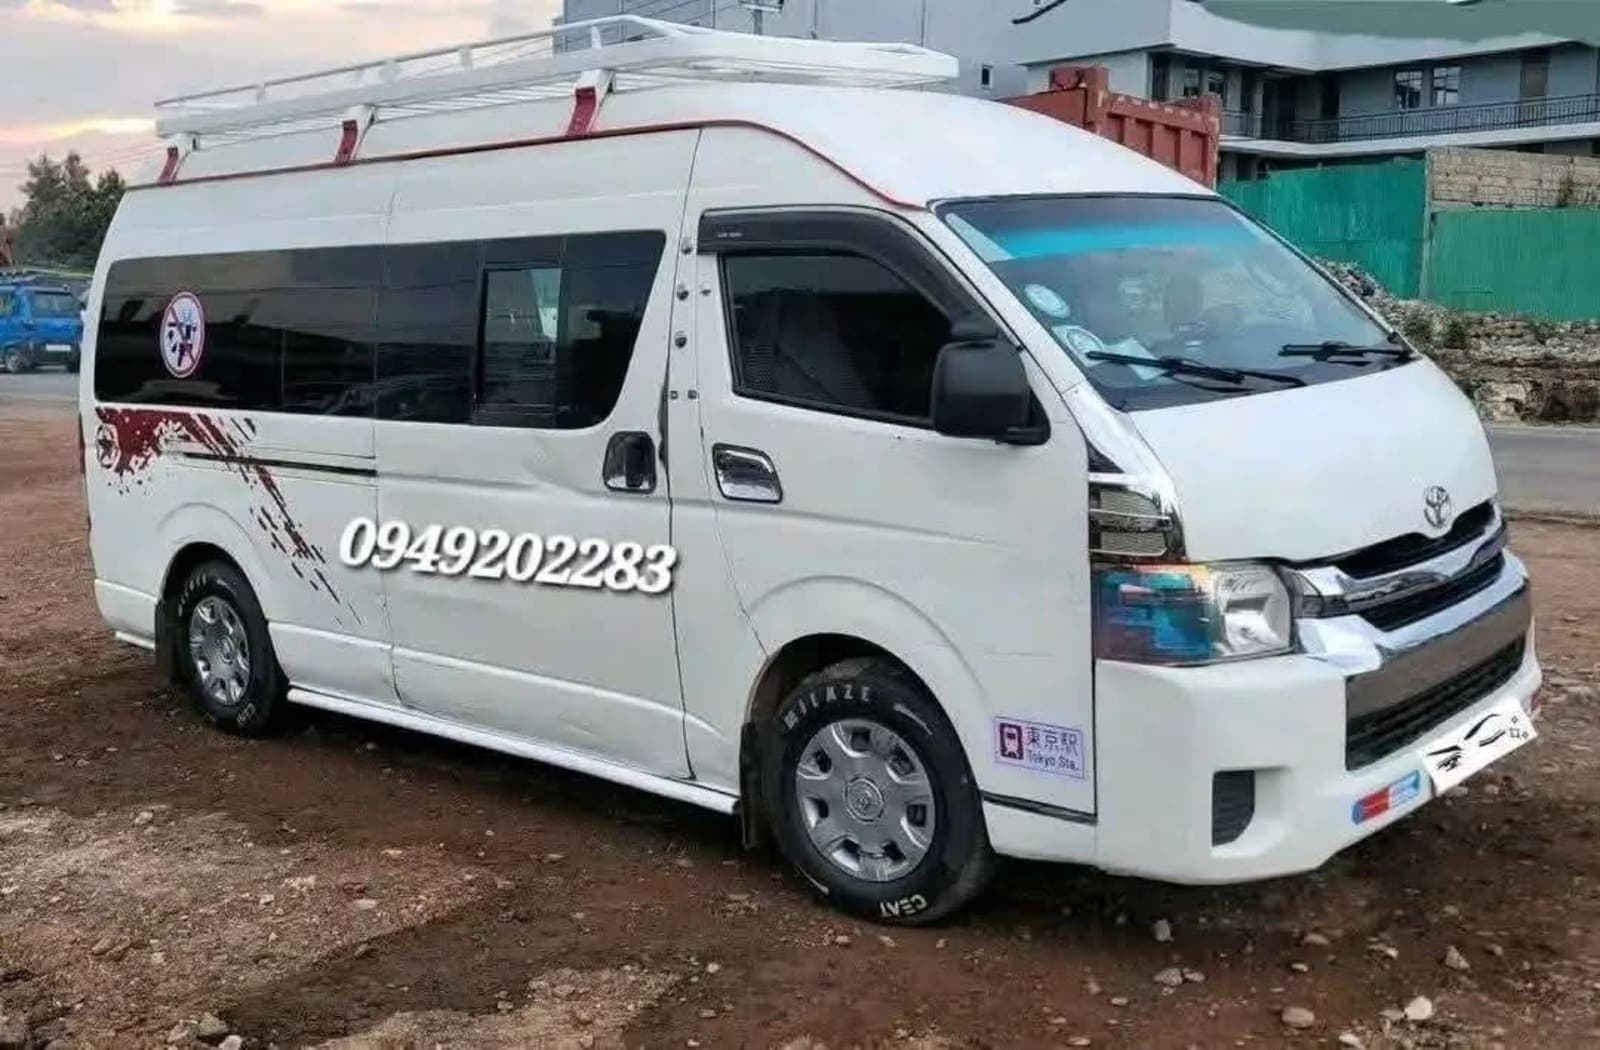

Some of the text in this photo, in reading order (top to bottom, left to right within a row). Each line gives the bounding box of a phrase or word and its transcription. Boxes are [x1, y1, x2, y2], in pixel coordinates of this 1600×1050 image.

[1024, 726, 1079, 757] 東京駅
[879, 894, 927, 917] CEAT
